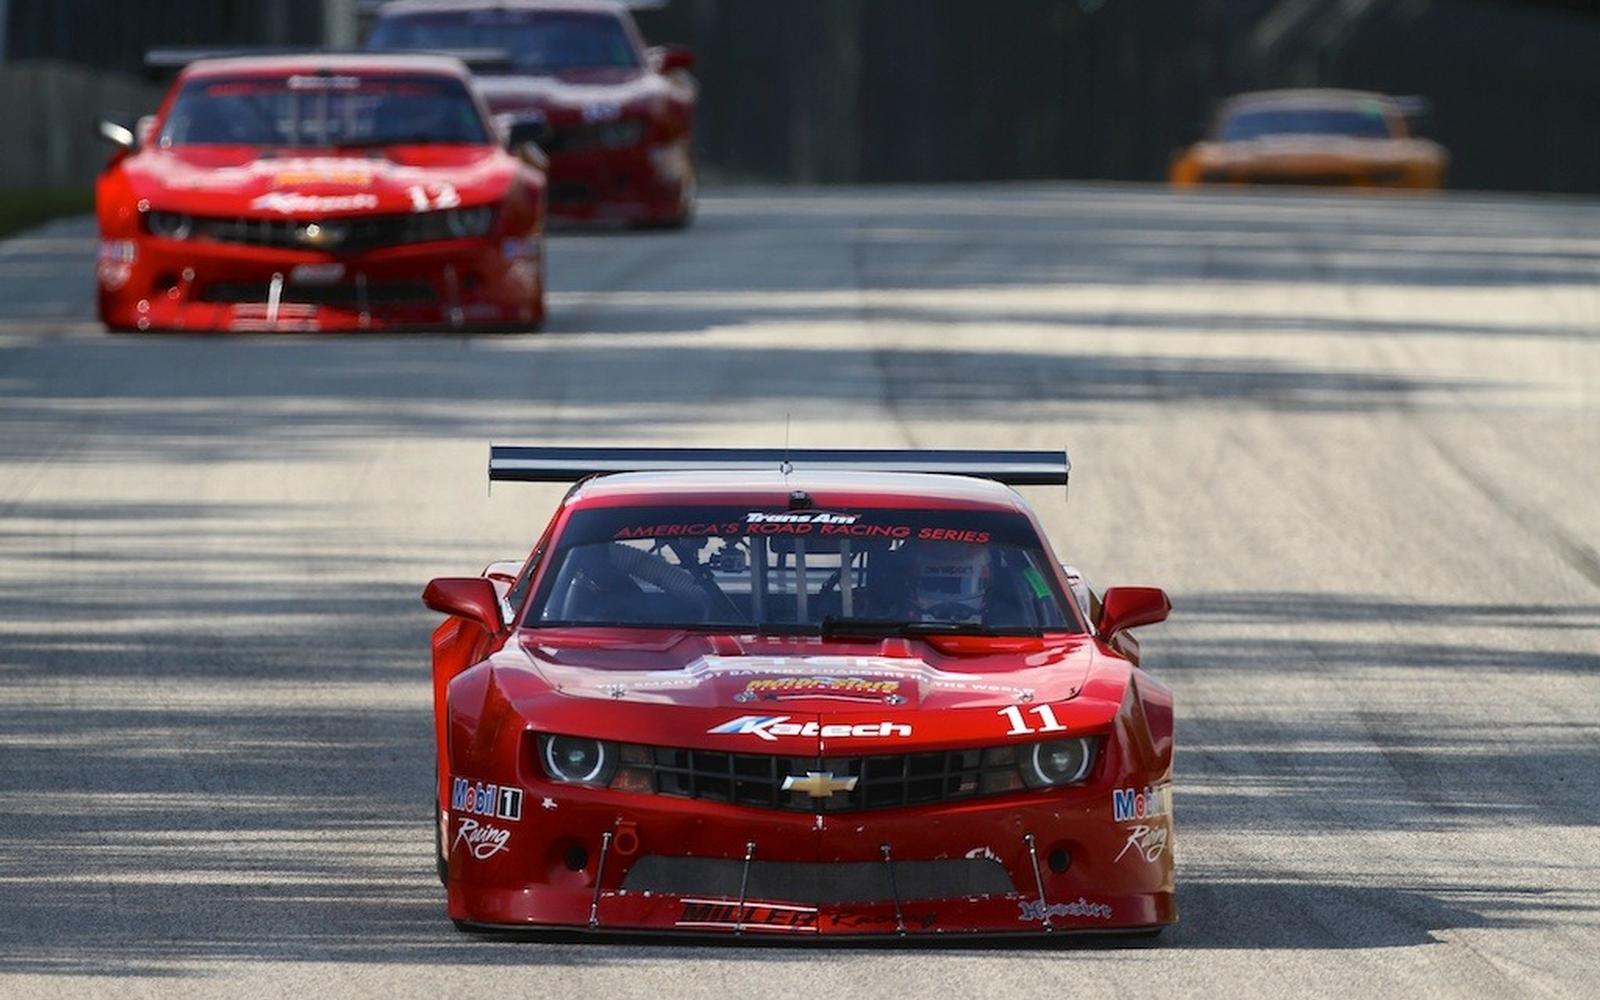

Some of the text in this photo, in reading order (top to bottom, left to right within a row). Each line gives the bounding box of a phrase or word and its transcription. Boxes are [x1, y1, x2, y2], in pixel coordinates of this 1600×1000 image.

[613, 522, 992, 544] AMERICA'S ROAD RACING SERIES
[706, 715, 913, 742] Katech
[997, 703, 1068, 737] 11
[451, 777, 498, 817] Mobil
